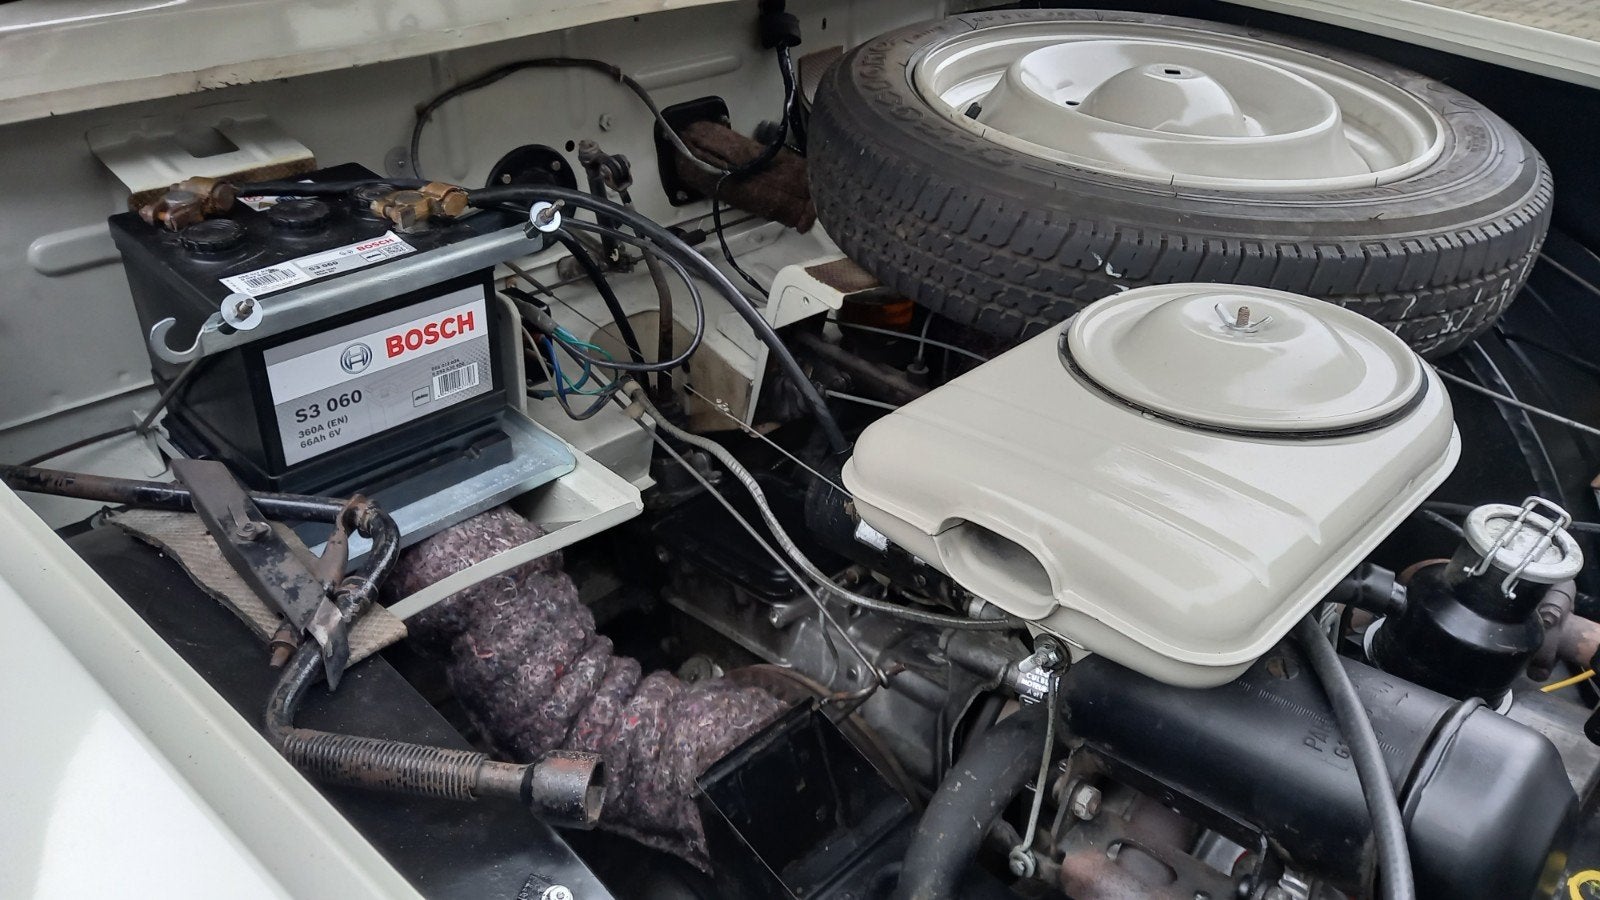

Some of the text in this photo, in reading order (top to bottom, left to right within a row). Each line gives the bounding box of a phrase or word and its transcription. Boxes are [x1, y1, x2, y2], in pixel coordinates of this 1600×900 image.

[356, 238, 395, 252] BOSCH
[385, 311, 475, 358] BOSCH
[294, 389, 363, 424] S3 060
[298, 414, 348, 439] 360A (EN)
[300, 427, 342, 449] 66Ah 6V
